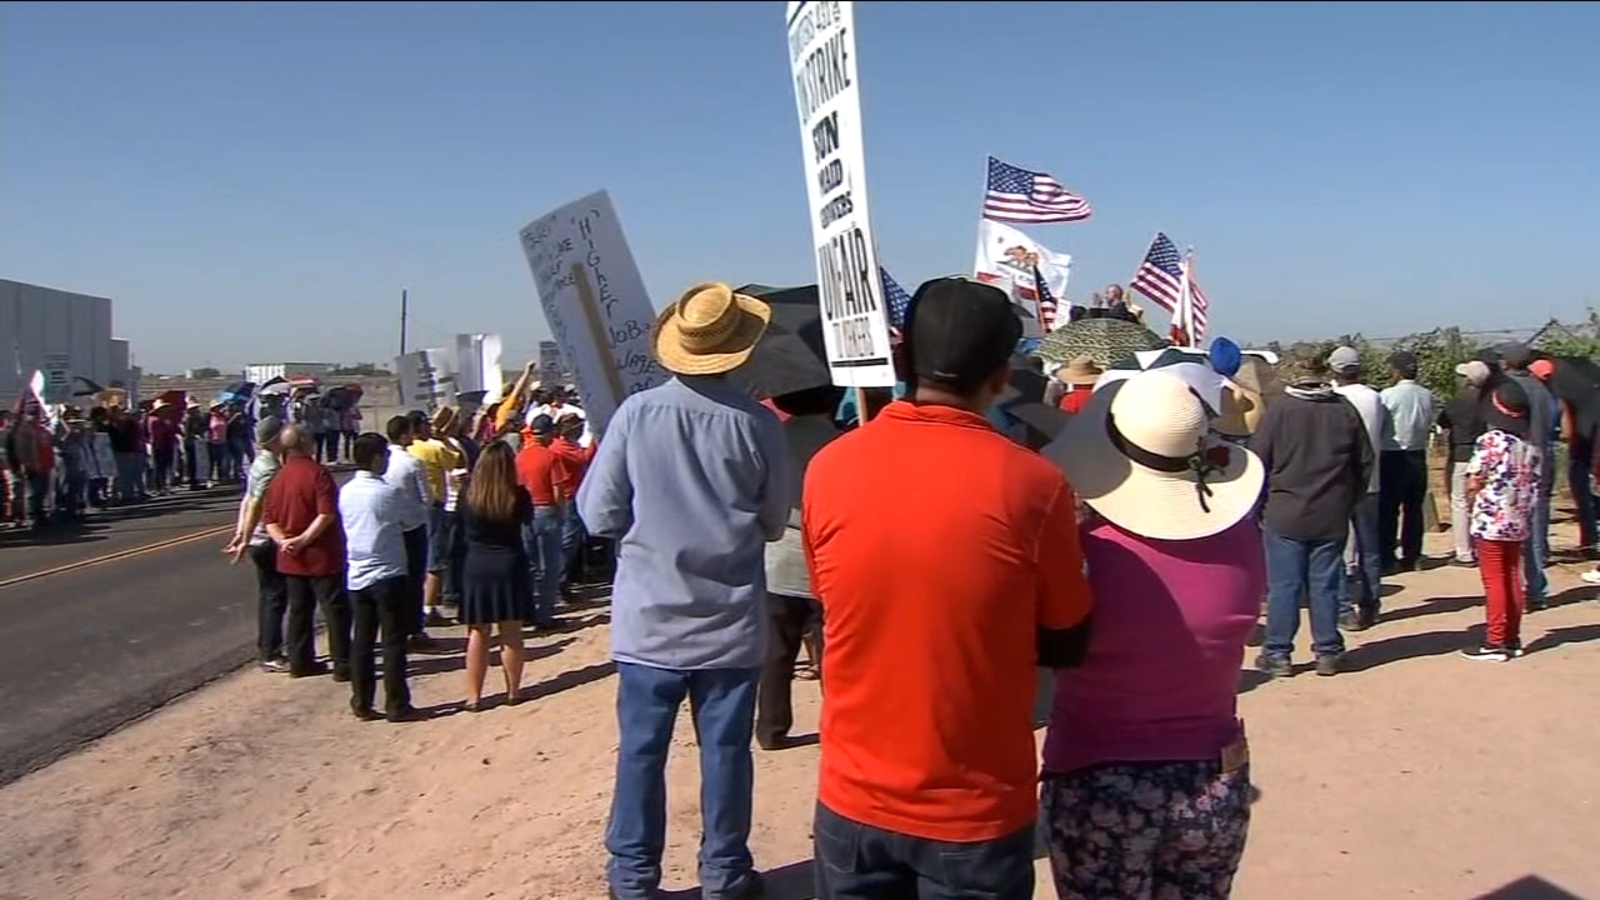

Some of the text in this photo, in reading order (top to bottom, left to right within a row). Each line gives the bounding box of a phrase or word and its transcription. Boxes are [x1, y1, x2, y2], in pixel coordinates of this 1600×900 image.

[805, 27, 851, 114] STRIKE
[811, 110, 840, 165] SUN
[818, 227, 877, 322] UNFAIR
